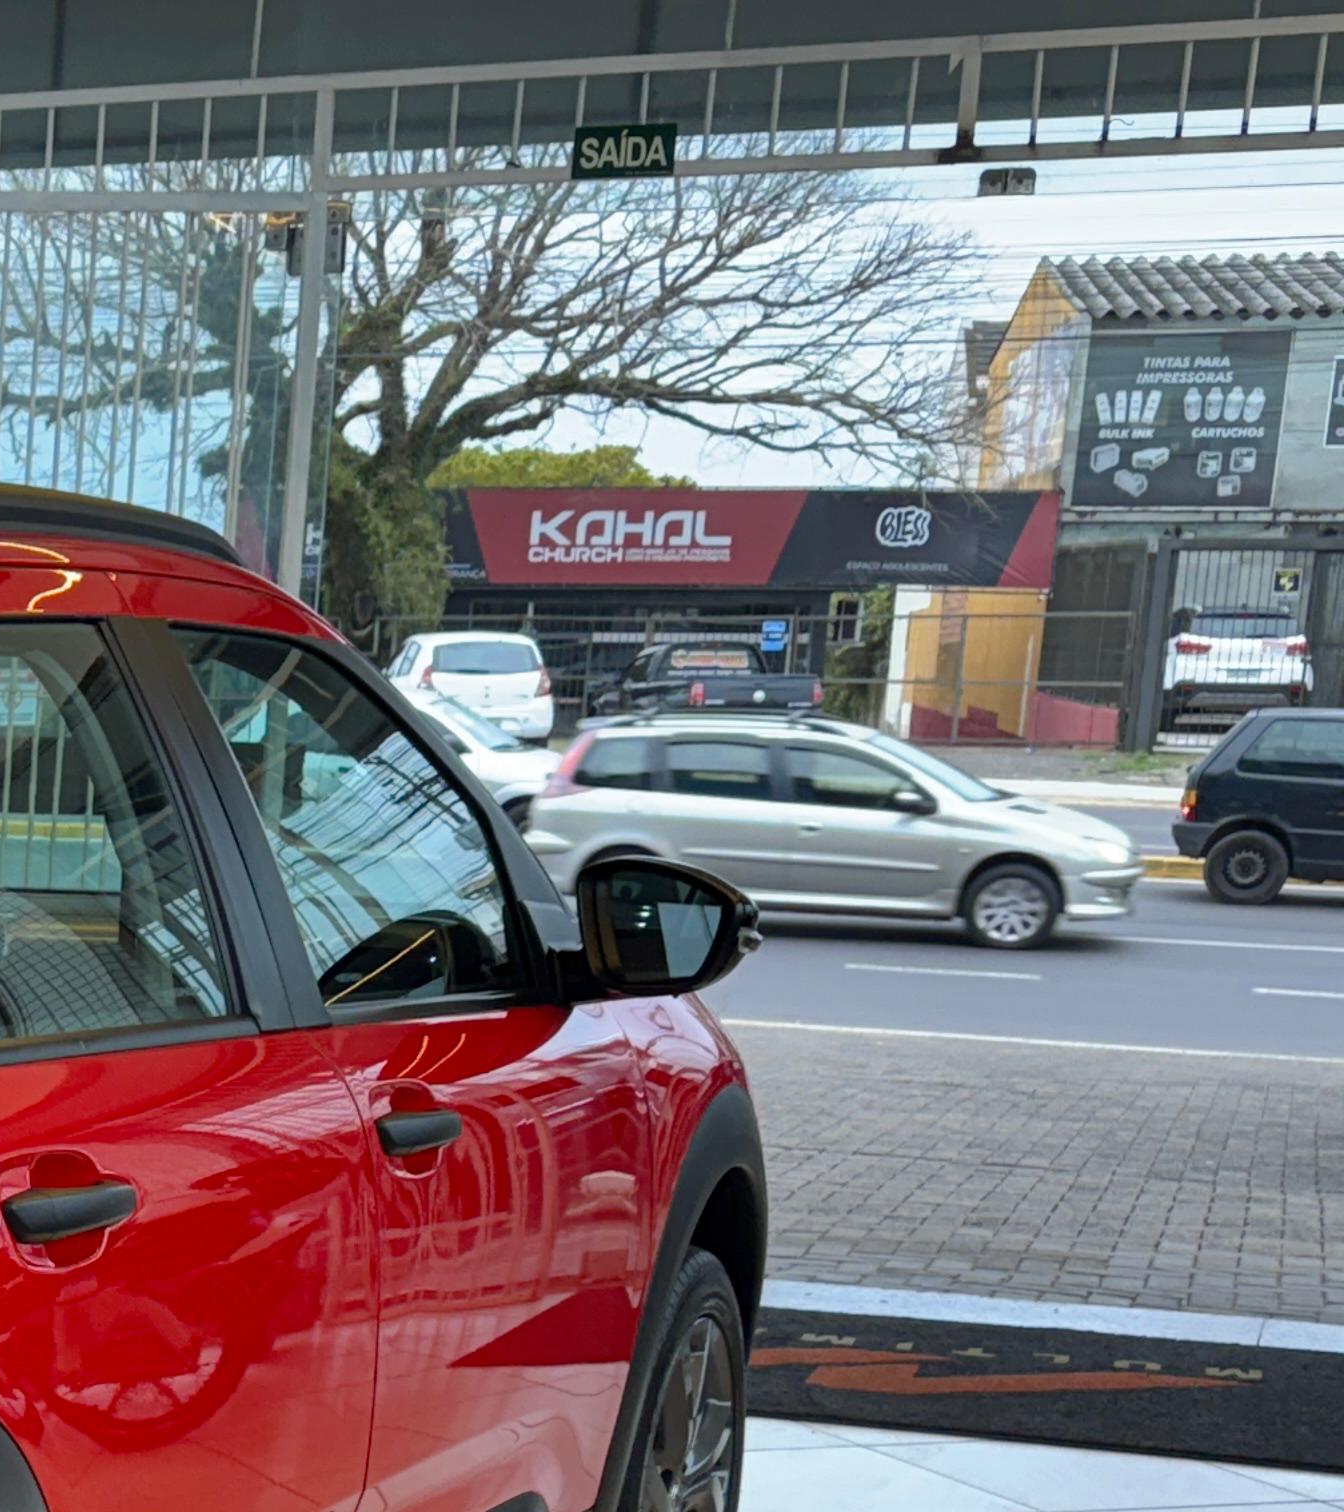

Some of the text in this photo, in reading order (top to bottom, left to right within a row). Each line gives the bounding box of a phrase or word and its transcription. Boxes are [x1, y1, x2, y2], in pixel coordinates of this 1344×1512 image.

[579, 128, 667, 169] SAÍDA
[1143, 356, 1231, 368] TINTAS PARA
[1136, 371, 1234, 384] IMPRESSORAS
[1098, 428, 1155, 439] BULK INK
[1191, 427, 1265, 438] CARTUCHOS
[529, 509, 733, 546] KAHAL
[876, 505, 932, 547] BLESS
[528, 547, 623, 563] CHURCH
